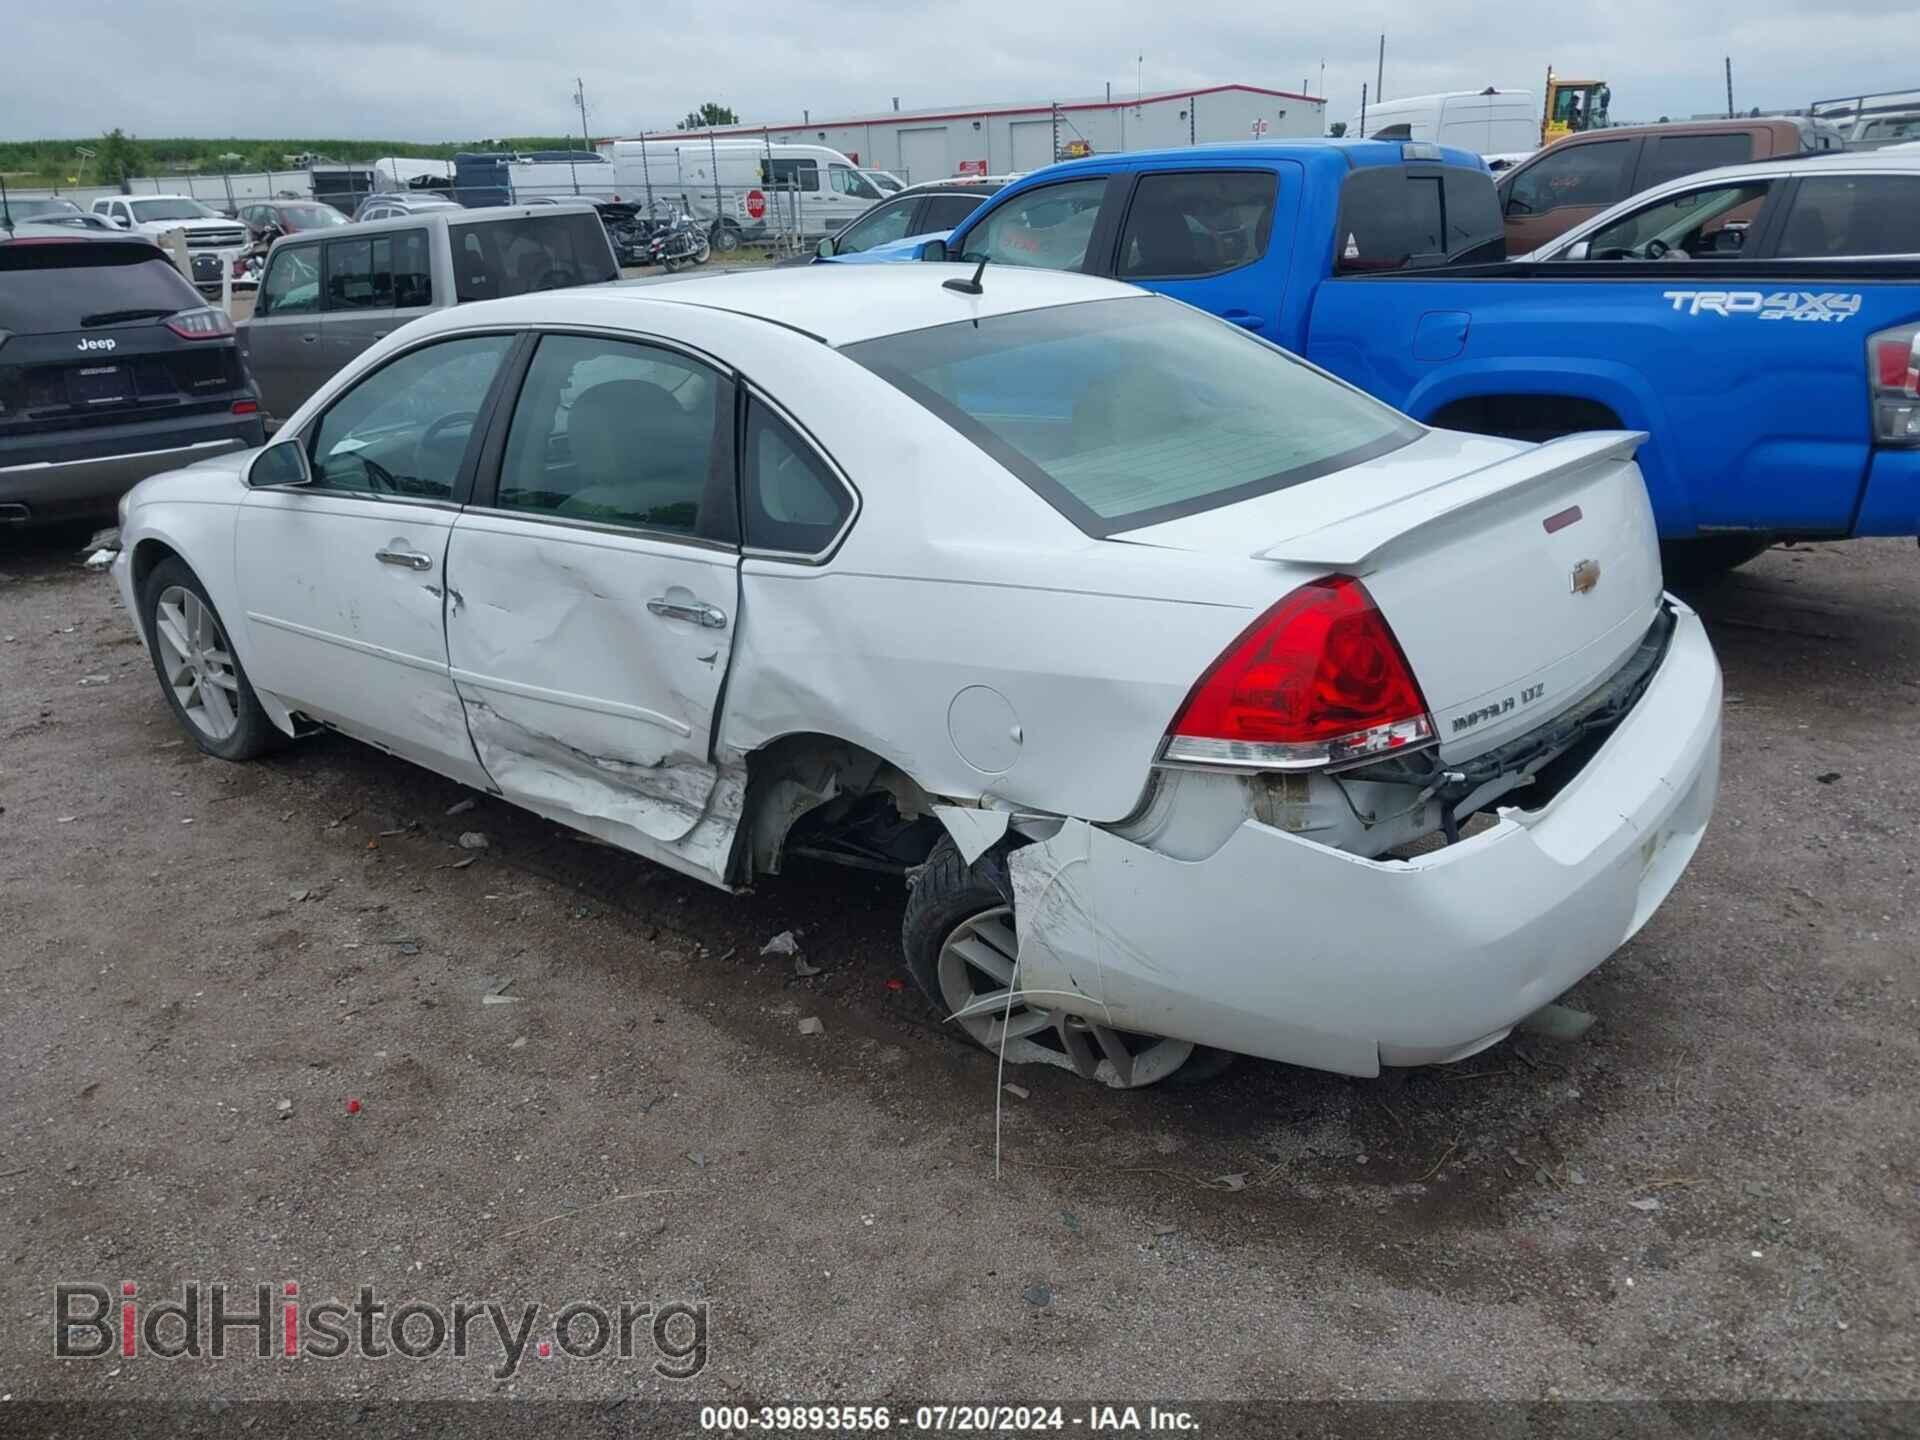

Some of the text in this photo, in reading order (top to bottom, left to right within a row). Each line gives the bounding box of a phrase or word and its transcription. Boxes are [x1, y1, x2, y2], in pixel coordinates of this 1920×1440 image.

[748, 198, 765, 209] STOP
[1663, 292, 1763, 316] TRD
[77, 338, 116, 350] Jeep
[1452, 682, 1544, 732] IMPALA LTZ
